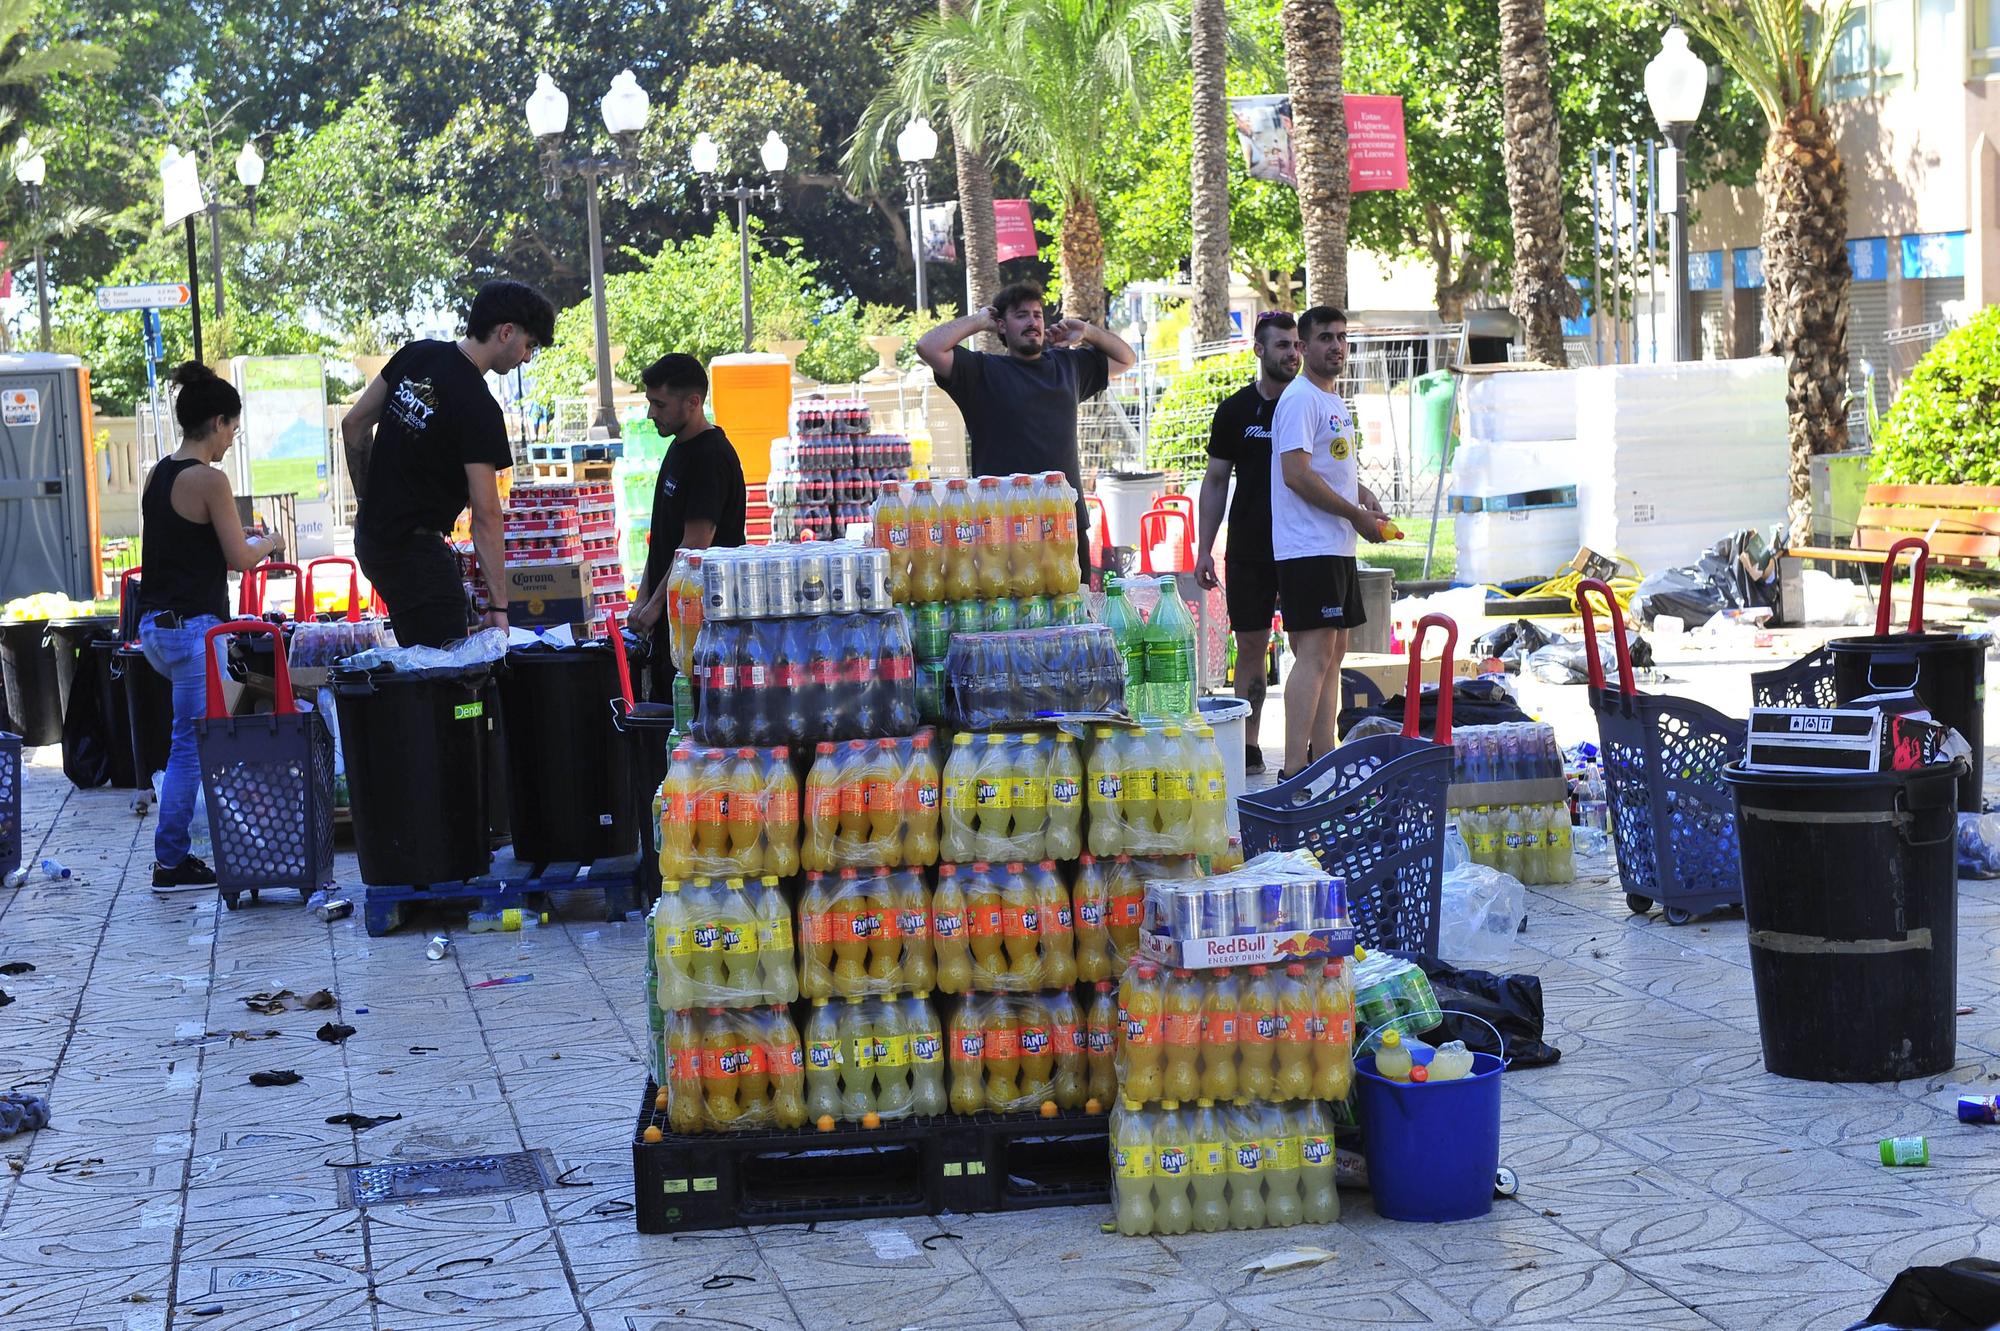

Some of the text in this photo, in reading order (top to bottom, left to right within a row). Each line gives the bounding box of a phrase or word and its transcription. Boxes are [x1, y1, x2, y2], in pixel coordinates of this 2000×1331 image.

[296, 521, 323, 533] cante
[1207, 935, 1266, 955] Red Bull
[1208, 953, 1266, 964] ENERGY DRINK
[1302, 1143, 1331, 1158] FANTA
